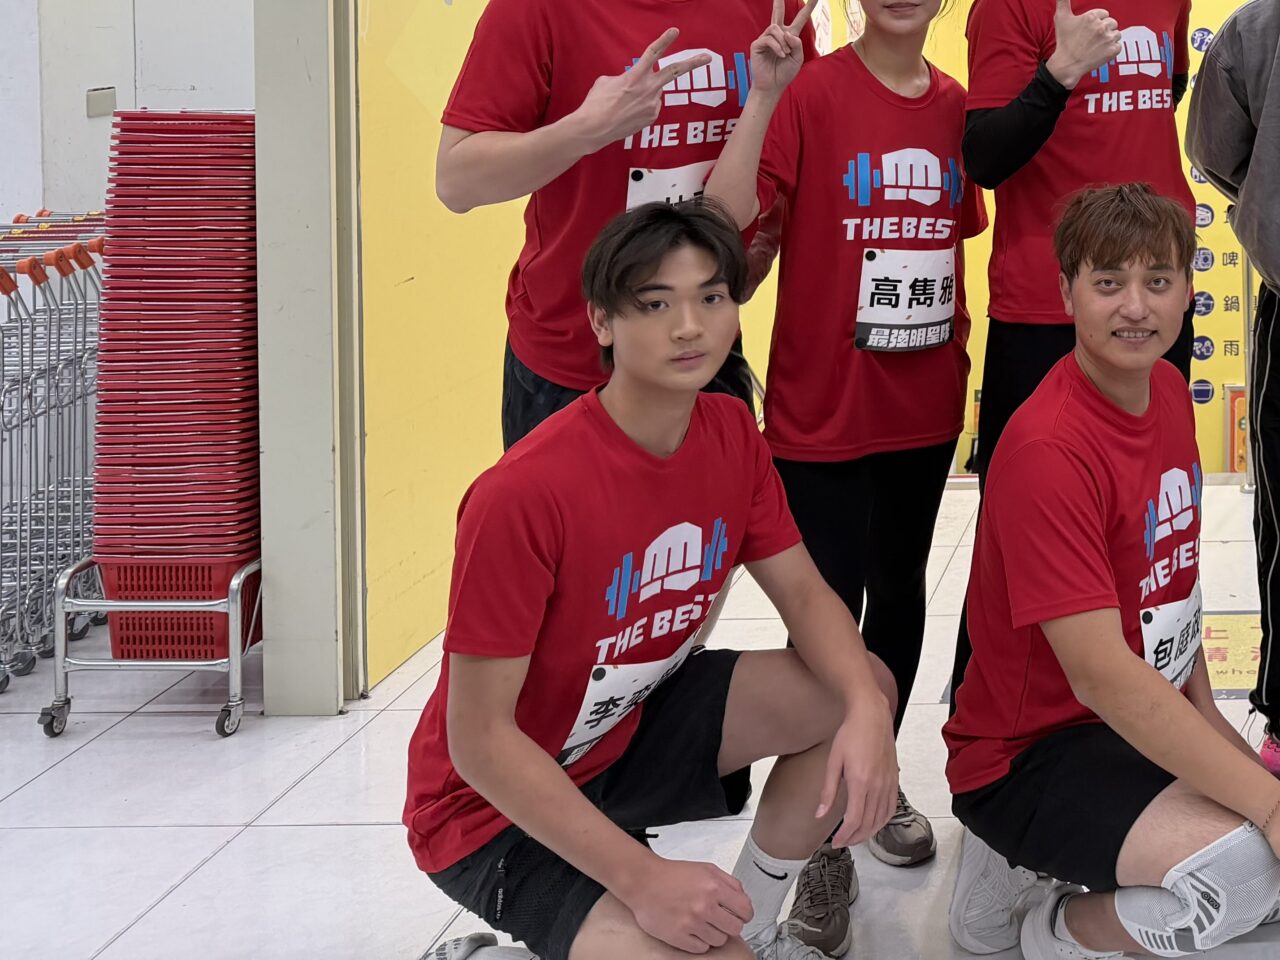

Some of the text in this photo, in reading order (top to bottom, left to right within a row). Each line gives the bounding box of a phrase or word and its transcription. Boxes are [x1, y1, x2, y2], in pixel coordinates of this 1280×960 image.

[1084, 89, 1171, 113] THE BES
[686, 118, 740, 145] BES
[842, 217, 955, 240] THE BES
[595, 617, 648, 665] THE
